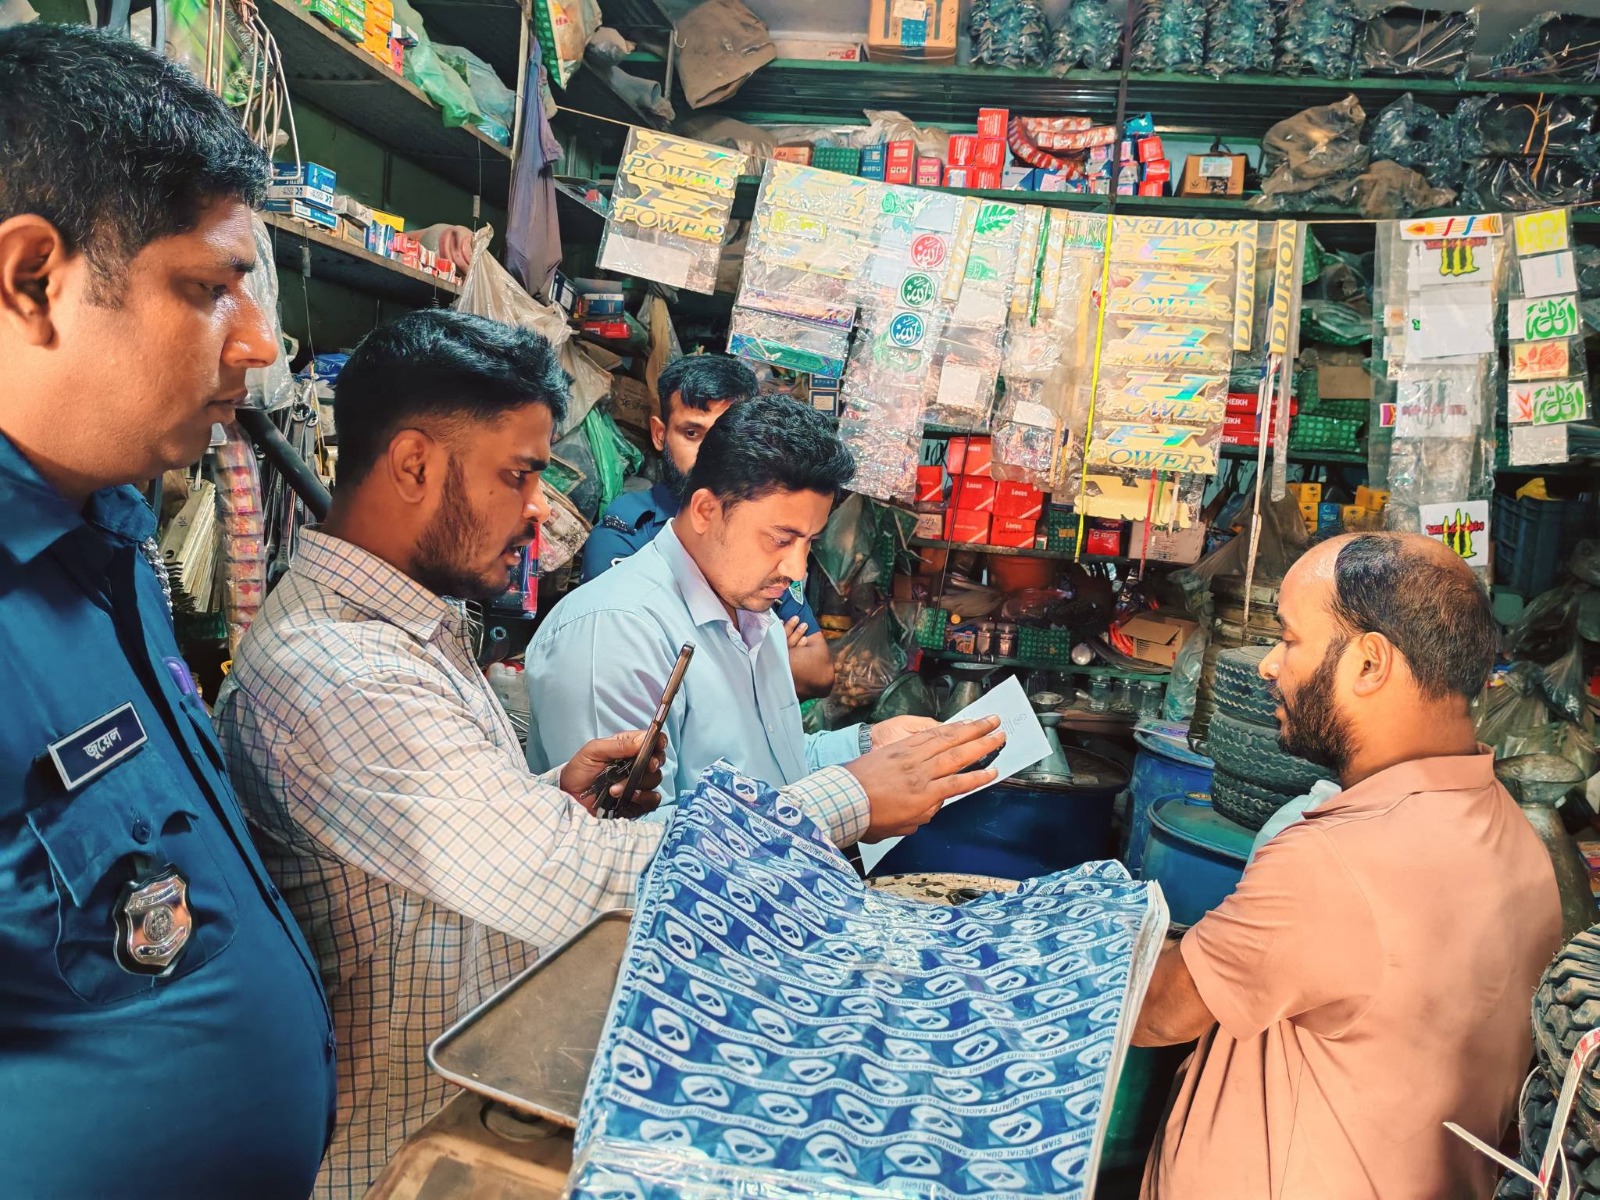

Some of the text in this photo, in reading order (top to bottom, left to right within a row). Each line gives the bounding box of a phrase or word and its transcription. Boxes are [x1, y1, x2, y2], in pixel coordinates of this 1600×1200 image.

[617, 206, 725, 236] POWER
[1122, 219, 1239, 236] POWER
[1224, 416, 1241, 425] EIKH
[82, 727, 122, 760] জুয়েল
[762, 821, 780, 837] SPECIAL
[736, 910, 757, 928] QUALITY
[705, 934, 728, 953] QUALITY
[756, 928, 777, 946] SPECIAL
[673, 958, 699, 976] QUALITY
[700, 970, 726, 985] SPECIAL
[640, 983, 666, 1002] QUALITY
[727, 982, 745, 993] SIAM
[808, 984, 834, 995] QUALITY
[667, 996, 694, 1016] SPECIAL
[1050, 1004, 1077, 1017] SPECIAL
[694, 1013, 712, 1028] SIAM
[784, 1010, 810, 1024] QUALITY
[1021, 1014, 1049, 1027] QUALITY
[930, 1031, 958, 1040] SPECIAL
[960, 1024, 978, 1036] SIAM
[625, 1030, 654, 1052] SPECIAL
[755, 1037, 784, 1054] QUALITY
[1068, 1039, 1087, 1050] SIAM
[654, 1048, 674, 1063] SIAM
[1038, 1046, 1067, 1059] SPECIAL
[722, 1070, 753, 1087] QUALITY
[754, 1080, 784, 1091] SPECIAL
[786, 1085, 807, 1094] SIAM
[1054, 1085, 1075, 1094] SIAM
[610, 1090, 632, 1103] SIAM
[856, 1088, 884, 1104] QUALITY
[1021, 1089, 1052, 1100] SPECIAL
[886, 1098, 918, 1106] SPECIAL
[990, 1097, 1019, 1114] QUALITY
[684, 1108, 717, 1120] QUALITY
[720, 1114, 751, 1126] SPECIAL
[754, 1122, 775, 1133] SIAM
[827, 1122, 858, 1142] QUALITY
[861, 1136, 892, 1146] SPECIAL
[1041, 1138, 1062, 1150] SIAM
[1006, 1147, 1039, 1158] SPECIAL
